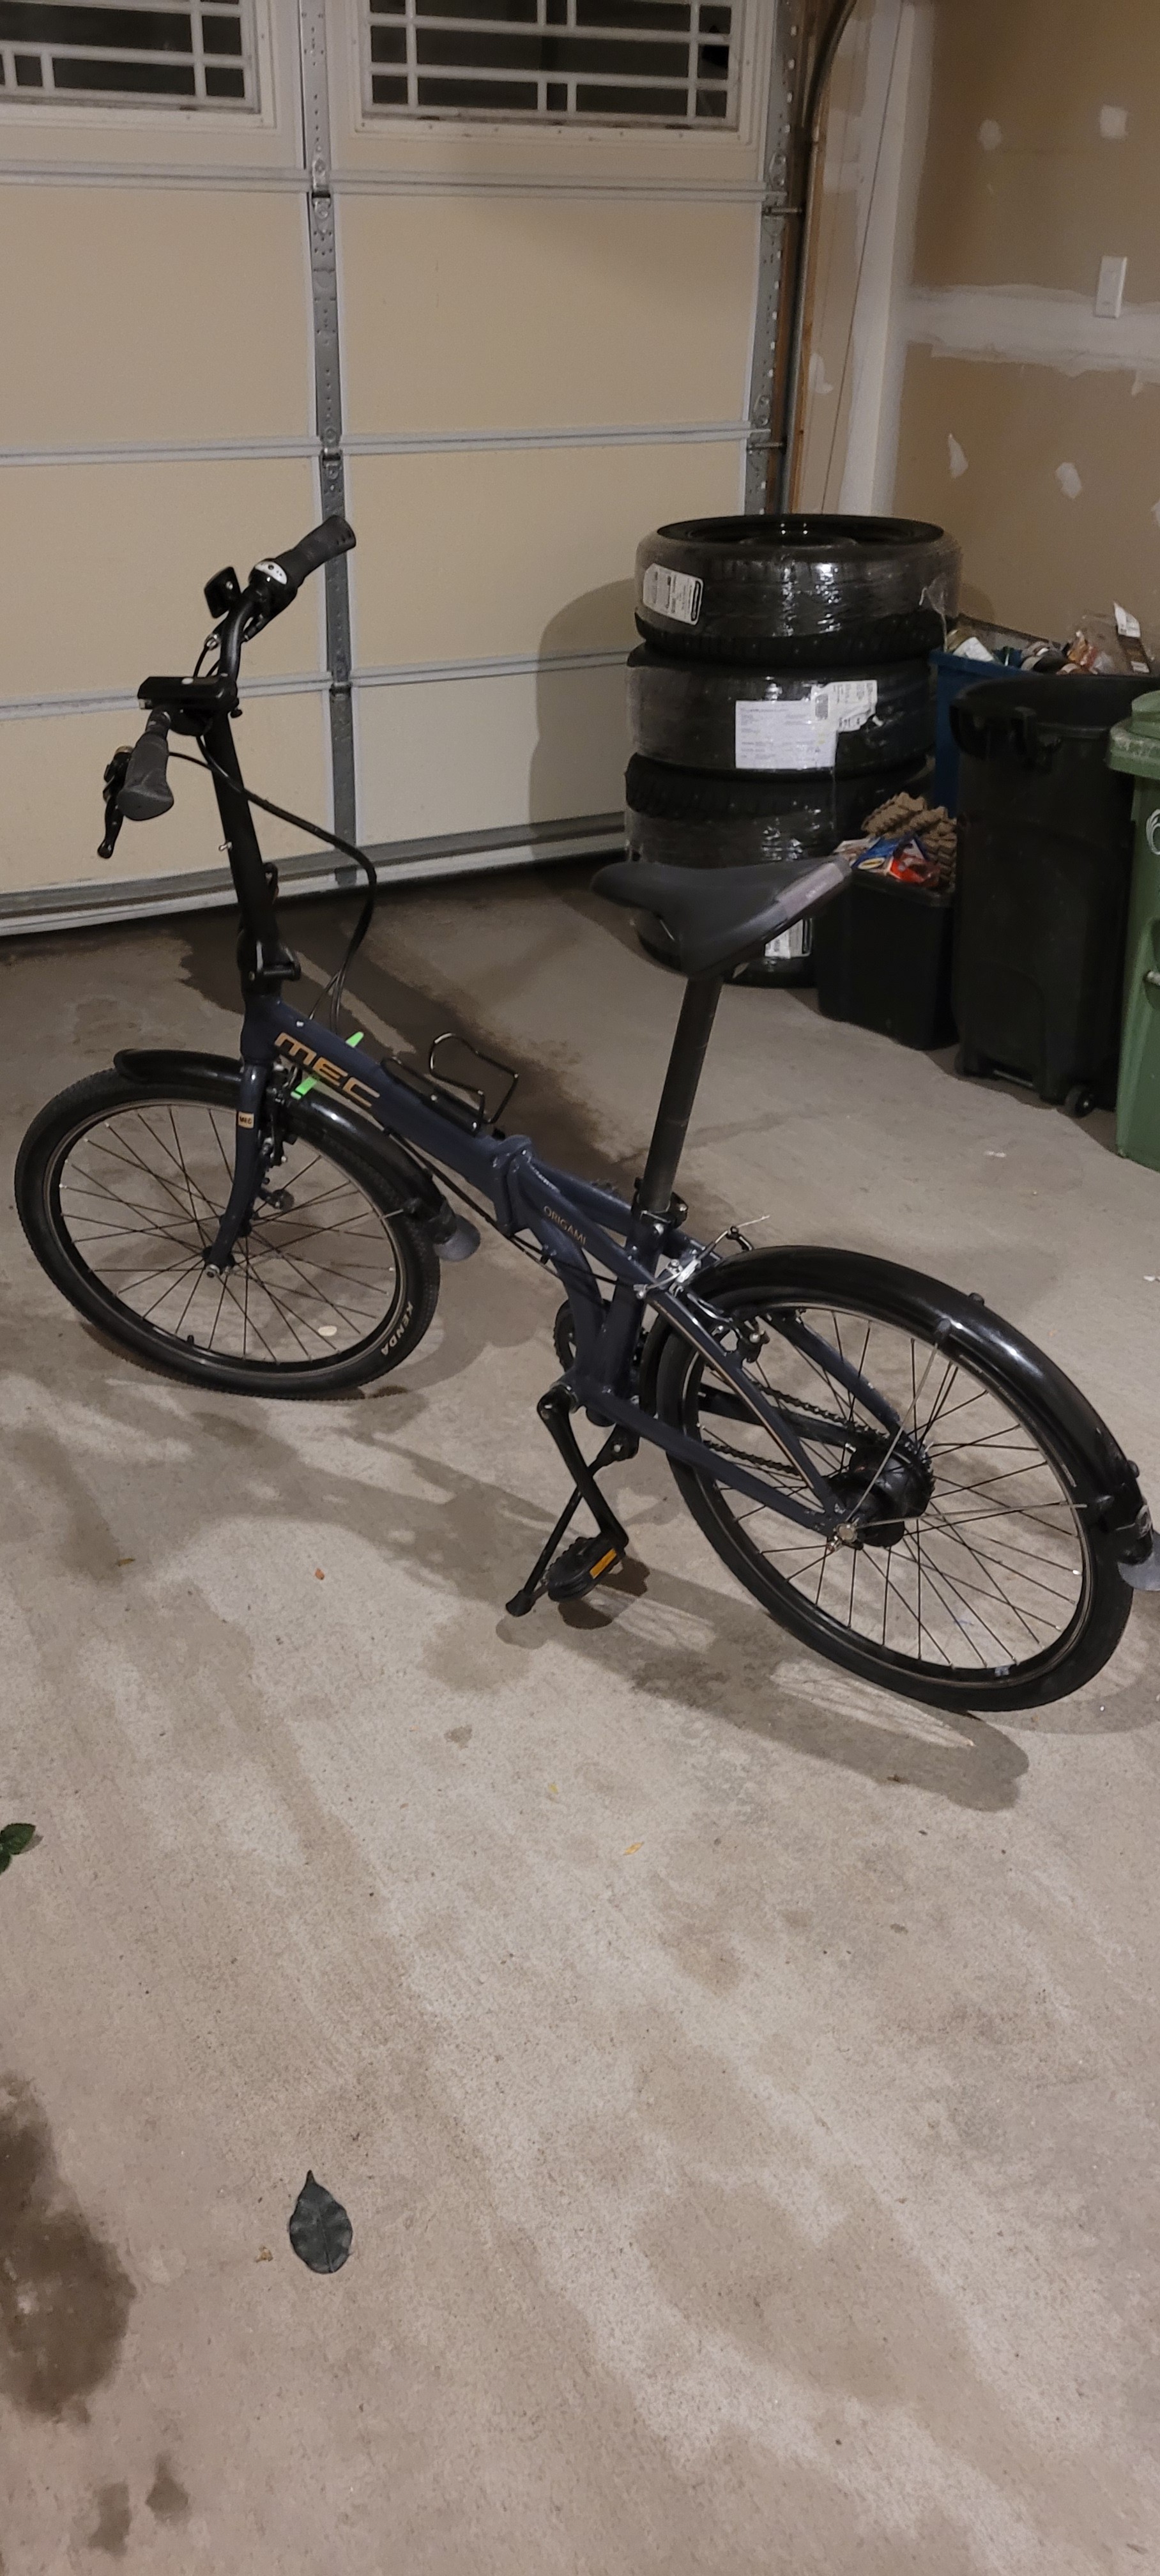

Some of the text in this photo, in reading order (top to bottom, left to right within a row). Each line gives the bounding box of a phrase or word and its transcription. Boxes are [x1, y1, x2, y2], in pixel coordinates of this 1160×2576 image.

[274, 1032, 380, 1108] MEC
[543, 1206, 586, 1245] ORIGAMI
[381, 1301, 413, 1356] KENDA
